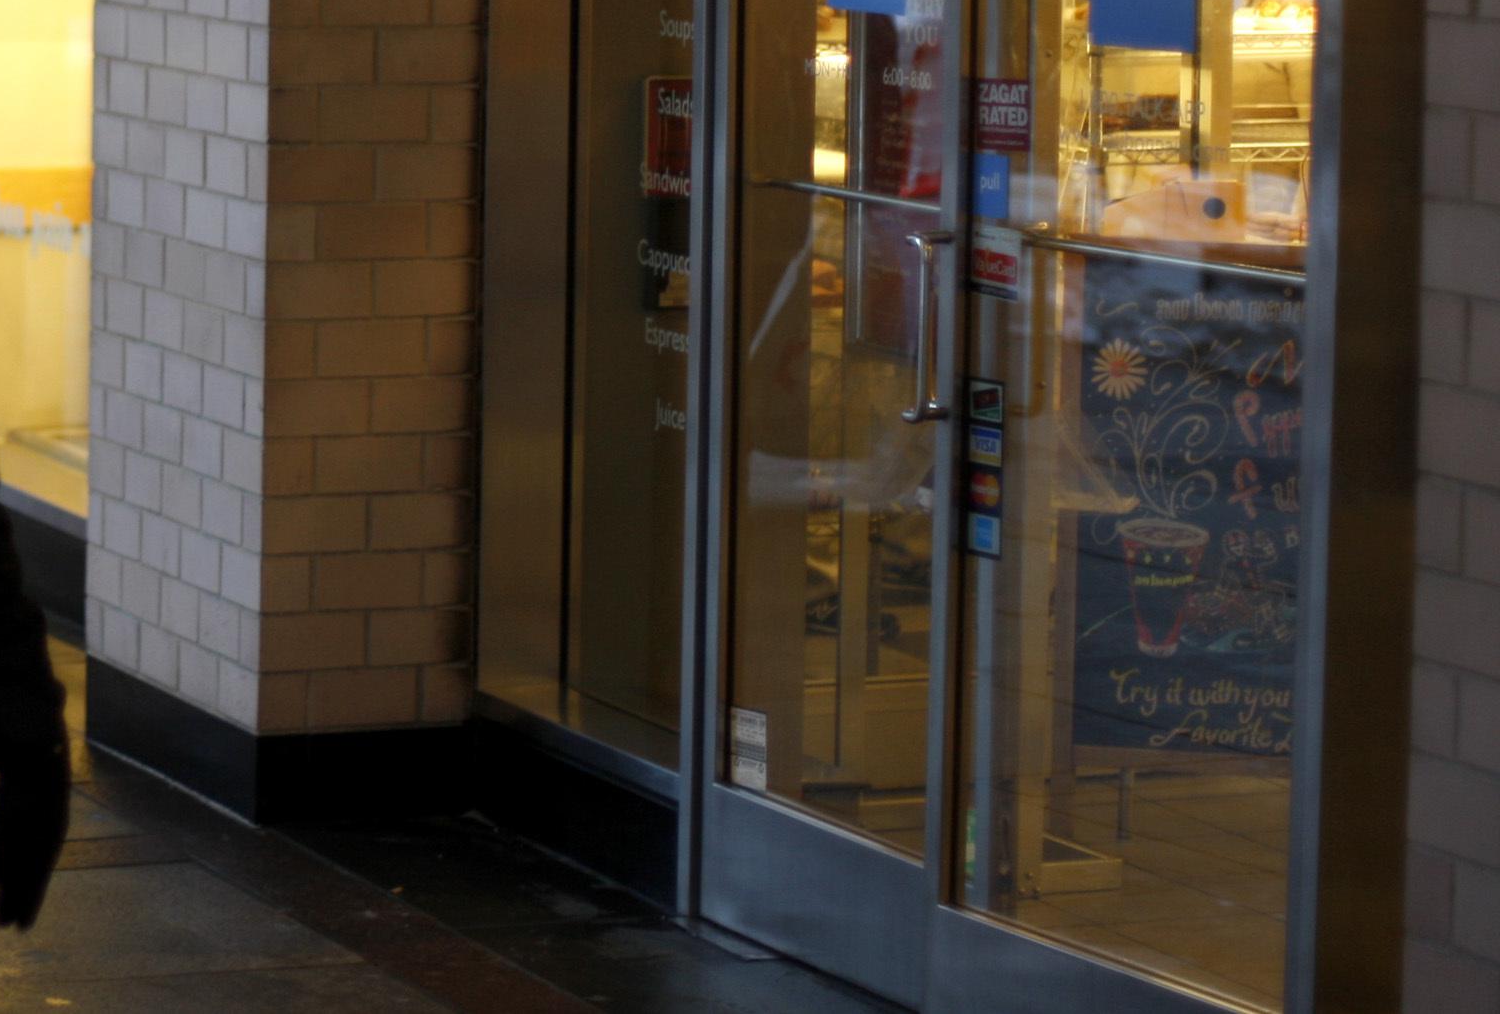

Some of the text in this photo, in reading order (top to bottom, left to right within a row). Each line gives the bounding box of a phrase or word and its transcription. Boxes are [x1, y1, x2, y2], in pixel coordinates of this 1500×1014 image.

[979, 83, 1028, 104] ZAGAT
[979, 106, 1028, 126] RATED
[639, 160, 691, 197] Sandwic
[980, 173, 1000, 195] pull
[637, 239, 691, 275] Cappucc
[974, 438, 997, 454] VISA
[1108, 668, 1291, 724] Try it with you
